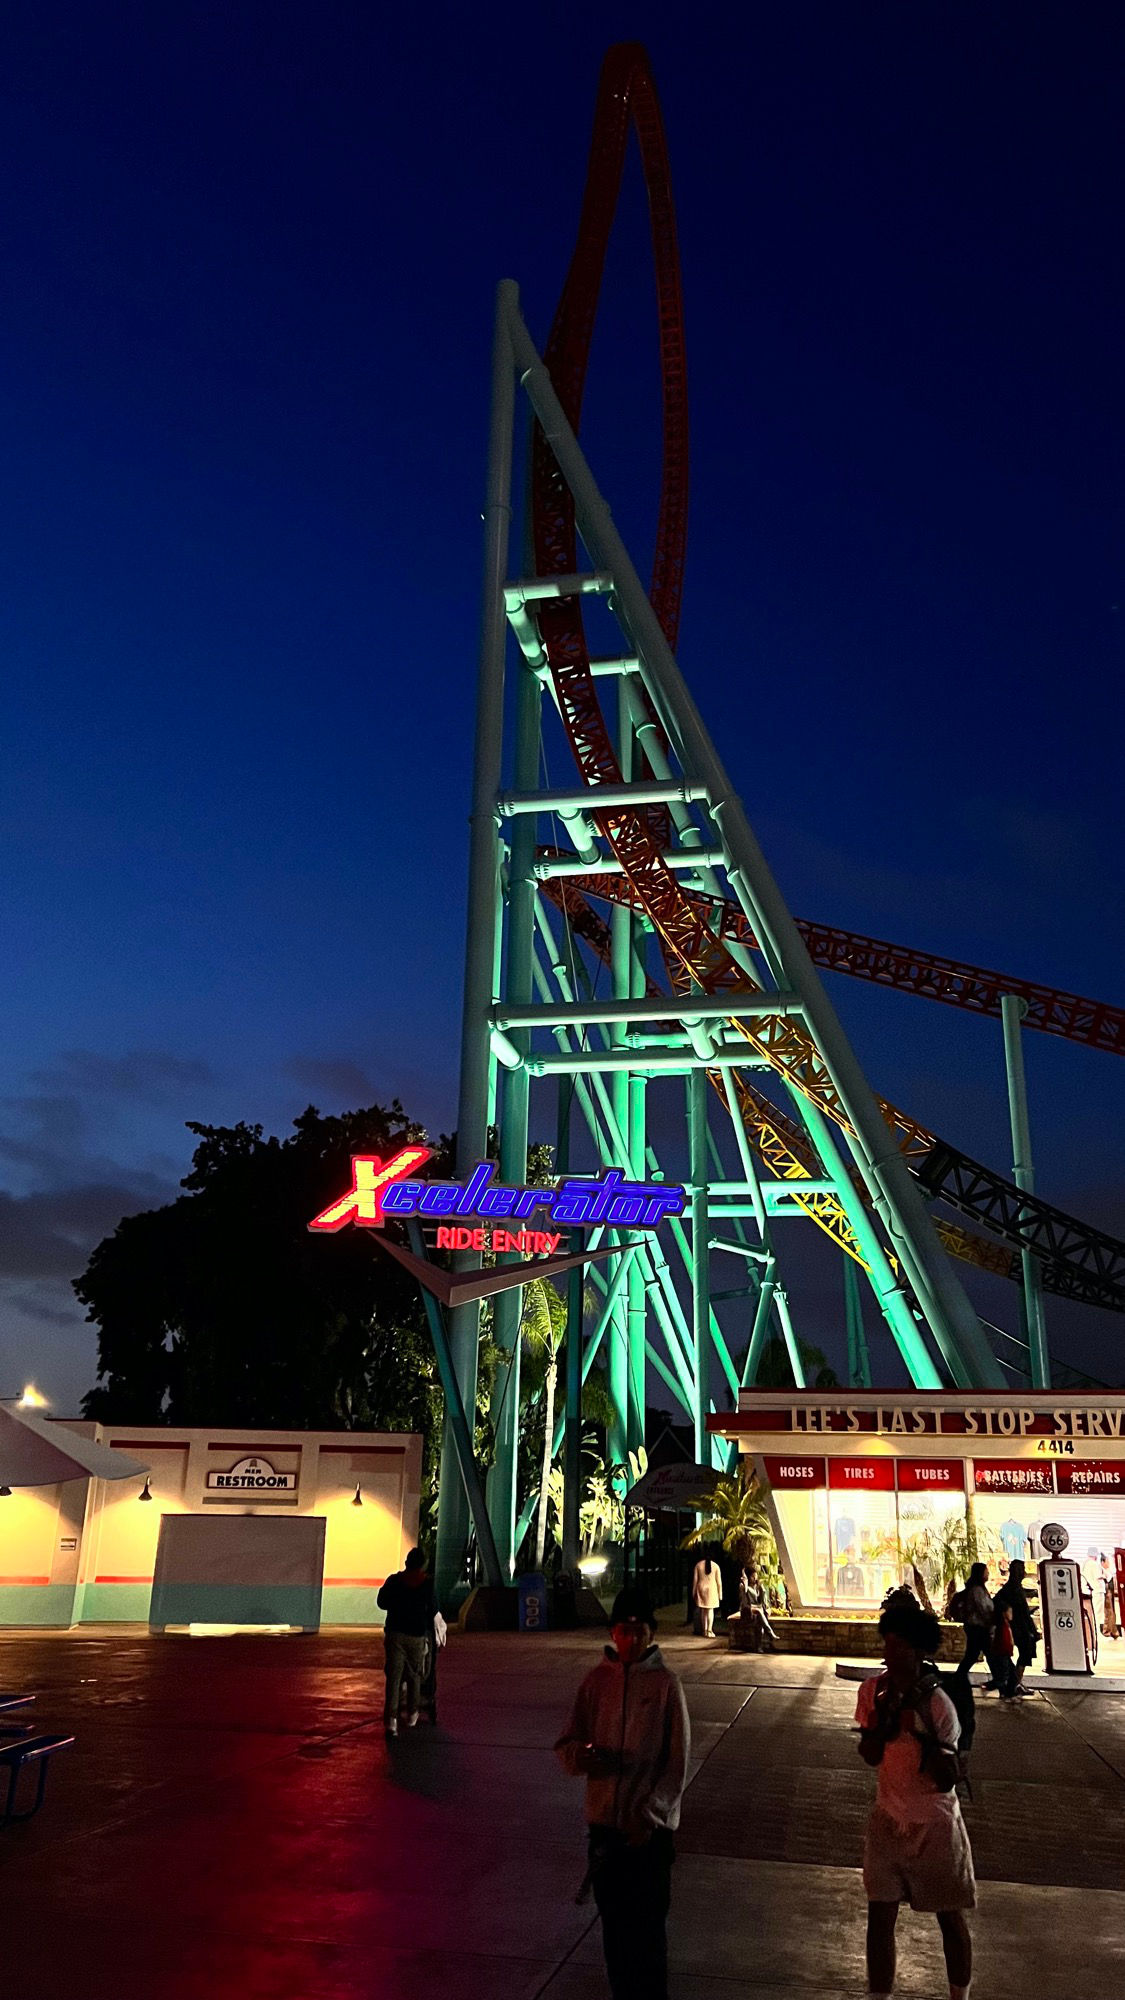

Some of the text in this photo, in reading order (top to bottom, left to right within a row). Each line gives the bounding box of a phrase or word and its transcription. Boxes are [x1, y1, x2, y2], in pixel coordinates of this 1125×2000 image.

[307, 1147, 685, 1231] Xcelerator
[436, 1227, 561, 1254] RIDE ENTRY
[791, 1406, 1122, 1436] LEE'S LAST STOP SERV
[1038, 1440, 1074, 1454] 4414
[780, 1467, 814, 1478] HOSES
[844, 1468, 874, 1479] TIRES
[915, 1469, 950, 1480] TUBES
[985, 1470, 1043, 1483] BATTERIES
[1072, 1471, 1121, 1483] REPAIRS
[217, 1476, 288, 1487] RESTROOM
[1048, 1535, 1063, 1546] 66
[1058, 1617, 1073, 1628] 66
